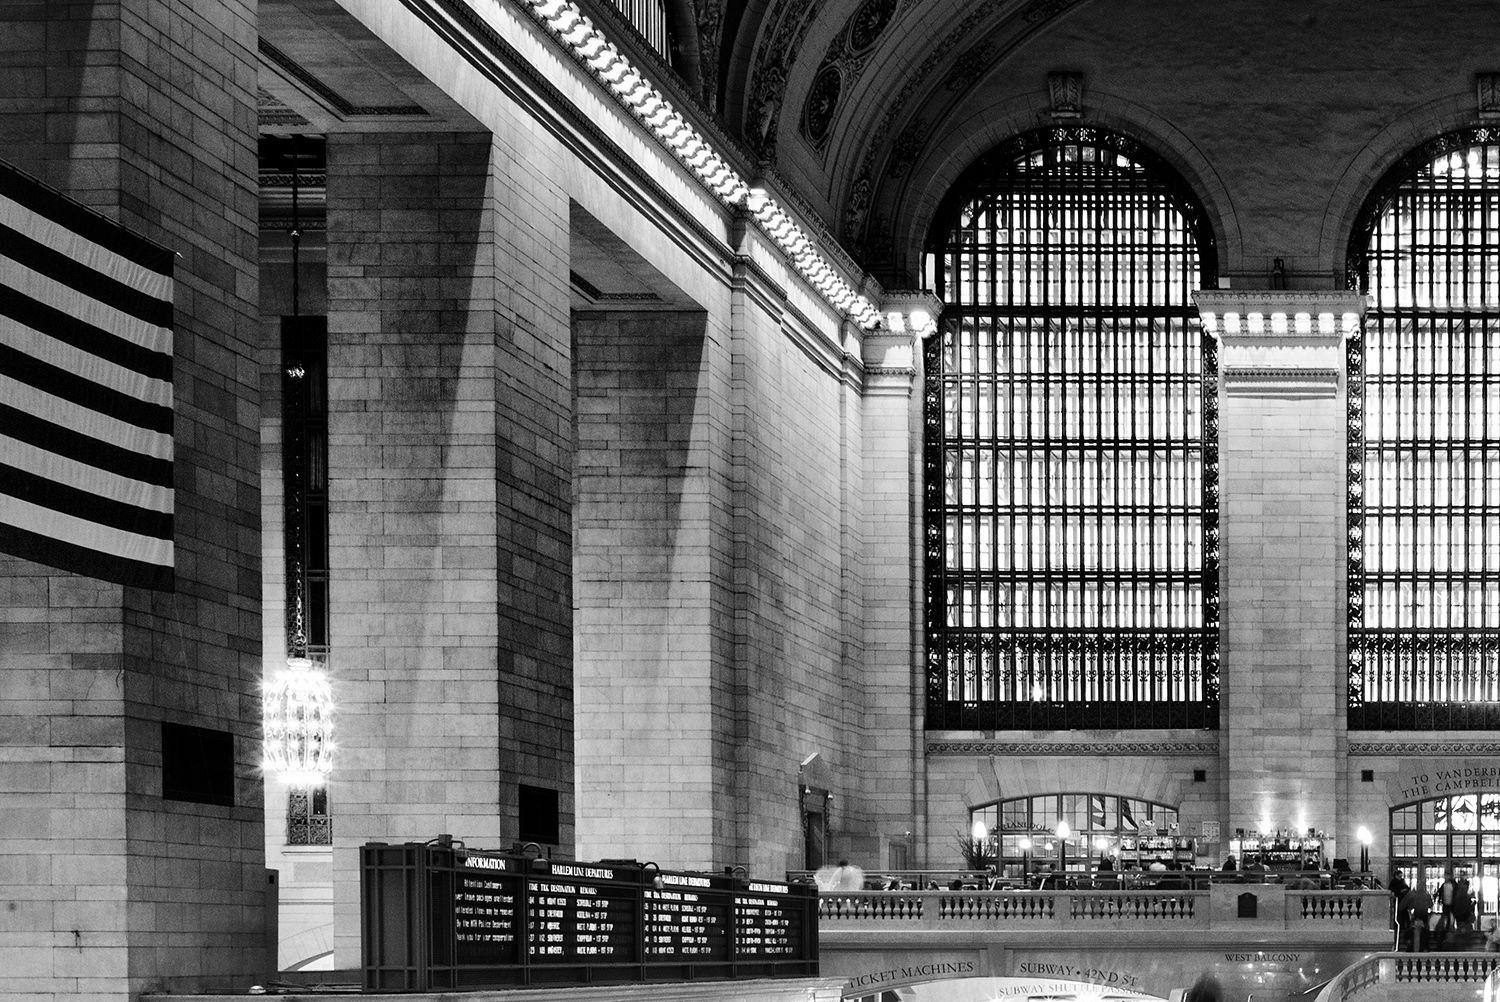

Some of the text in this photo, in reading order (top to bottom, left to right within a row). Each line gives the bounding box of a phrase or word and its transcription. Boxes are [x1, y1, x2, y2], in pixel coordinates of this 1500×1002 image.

[1402, 785, 1429, 798] THE
[1435, 778, 1500, 792] CAMPBELL
[1412, 774, 1429, 785] TO
[1225, 953, 1300, 962] WEST BALCONY
[850, 961, 974, 988] TICKET MACHINES
[1020, 962, 1138, 986] SUBWAY 42ND ST
[1000, 984, 1045, 997] SUBWAY
[1049, 982, 1096, 993] SHUTTLE
